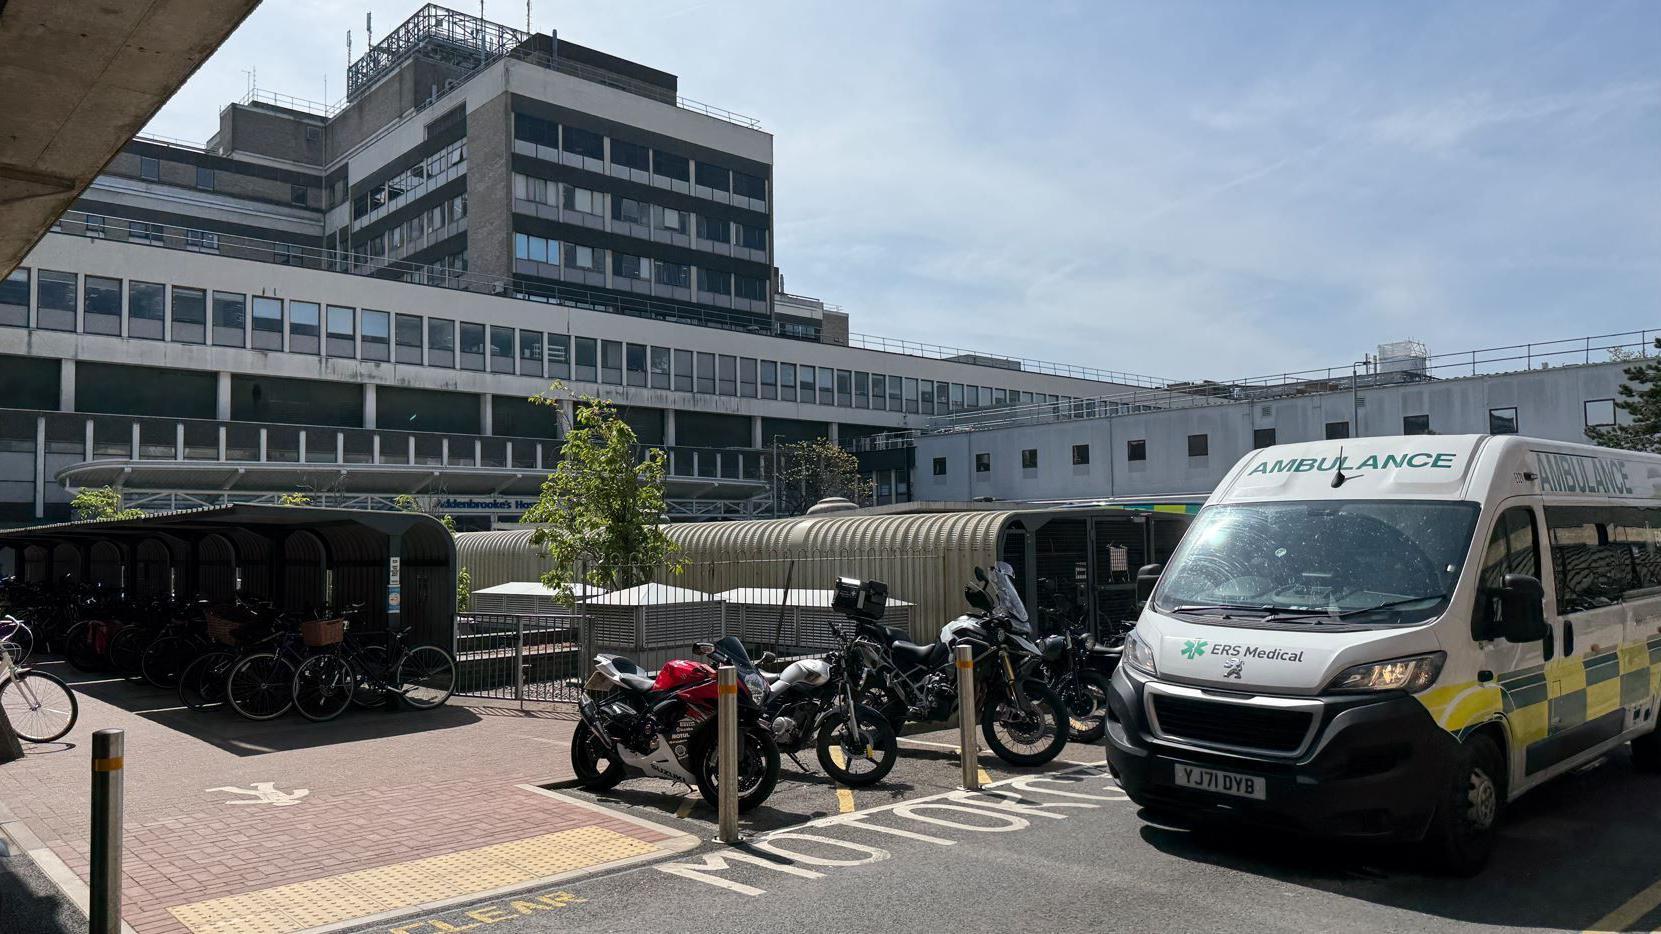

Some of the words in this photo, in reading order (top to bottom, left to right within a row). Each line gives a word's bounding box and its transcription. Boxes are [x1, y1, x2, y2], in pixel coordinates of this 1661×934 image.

[1247, 453, 1457, 477] AMBULANCE
[1536, 453, 1633, 495] AMBULANCE
[1210, 643, 1242, 657] ERS
[1243, 646, 1304, 663] Medical
[1184, 767, 1218, 788] YJ71
[1223, 775, 1255, 795] DYB
[654, 772, 1133, 897] MOTORC
